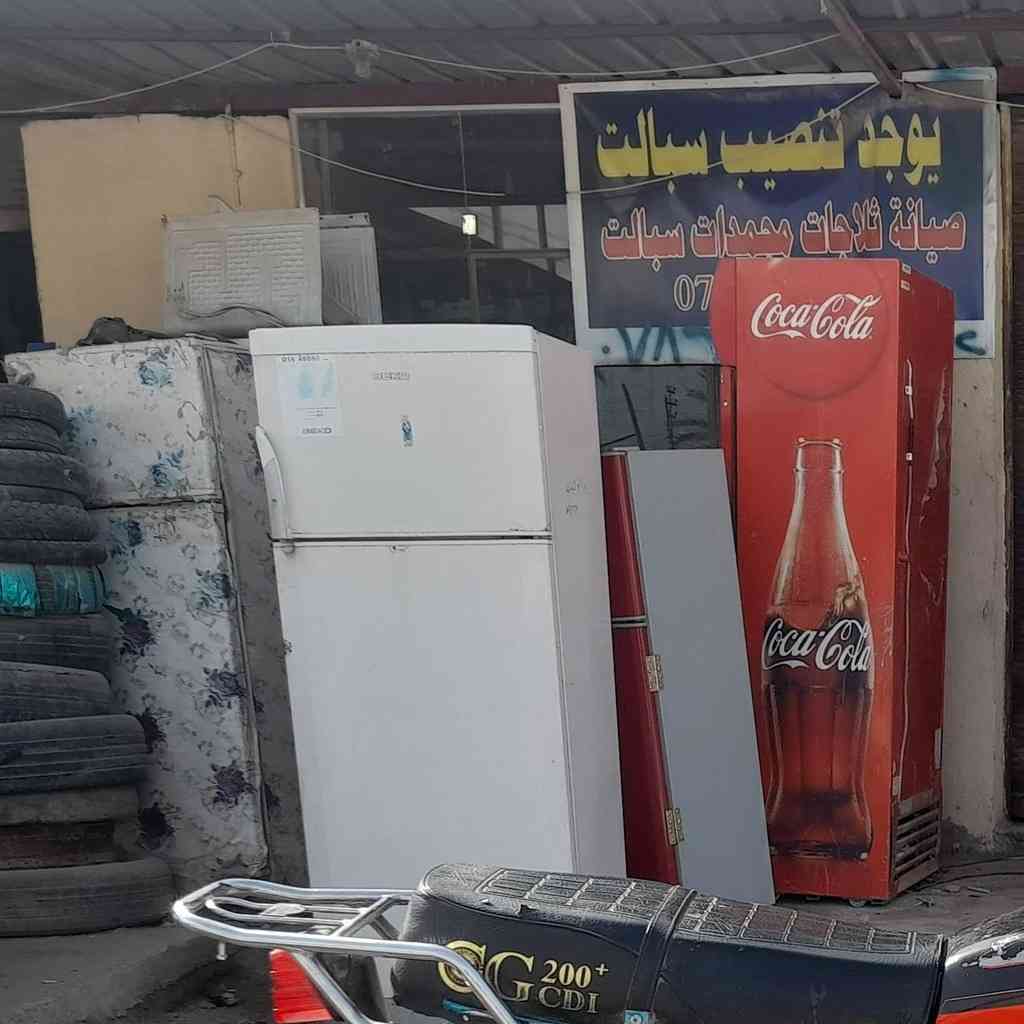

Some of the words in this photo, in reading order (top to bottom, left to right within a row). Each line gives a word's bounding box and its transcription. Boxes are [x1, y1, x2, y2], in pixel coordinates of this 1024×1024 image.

[597, 105, 710, 195] سبالت
[720, 107, 845, 191] تنصيب
[857, 111, 942, 186] يوجد
[600, 206, 686, 273] سبالت
[799, 196, 883, 259] ثلاجات
[888, 196, 967, 265] صيانة
[751, 292, 882, 339] Coca-Cola
[761, 617, 870, 672] Coca-Cola
[537, 985, 600, 1014] CDI
